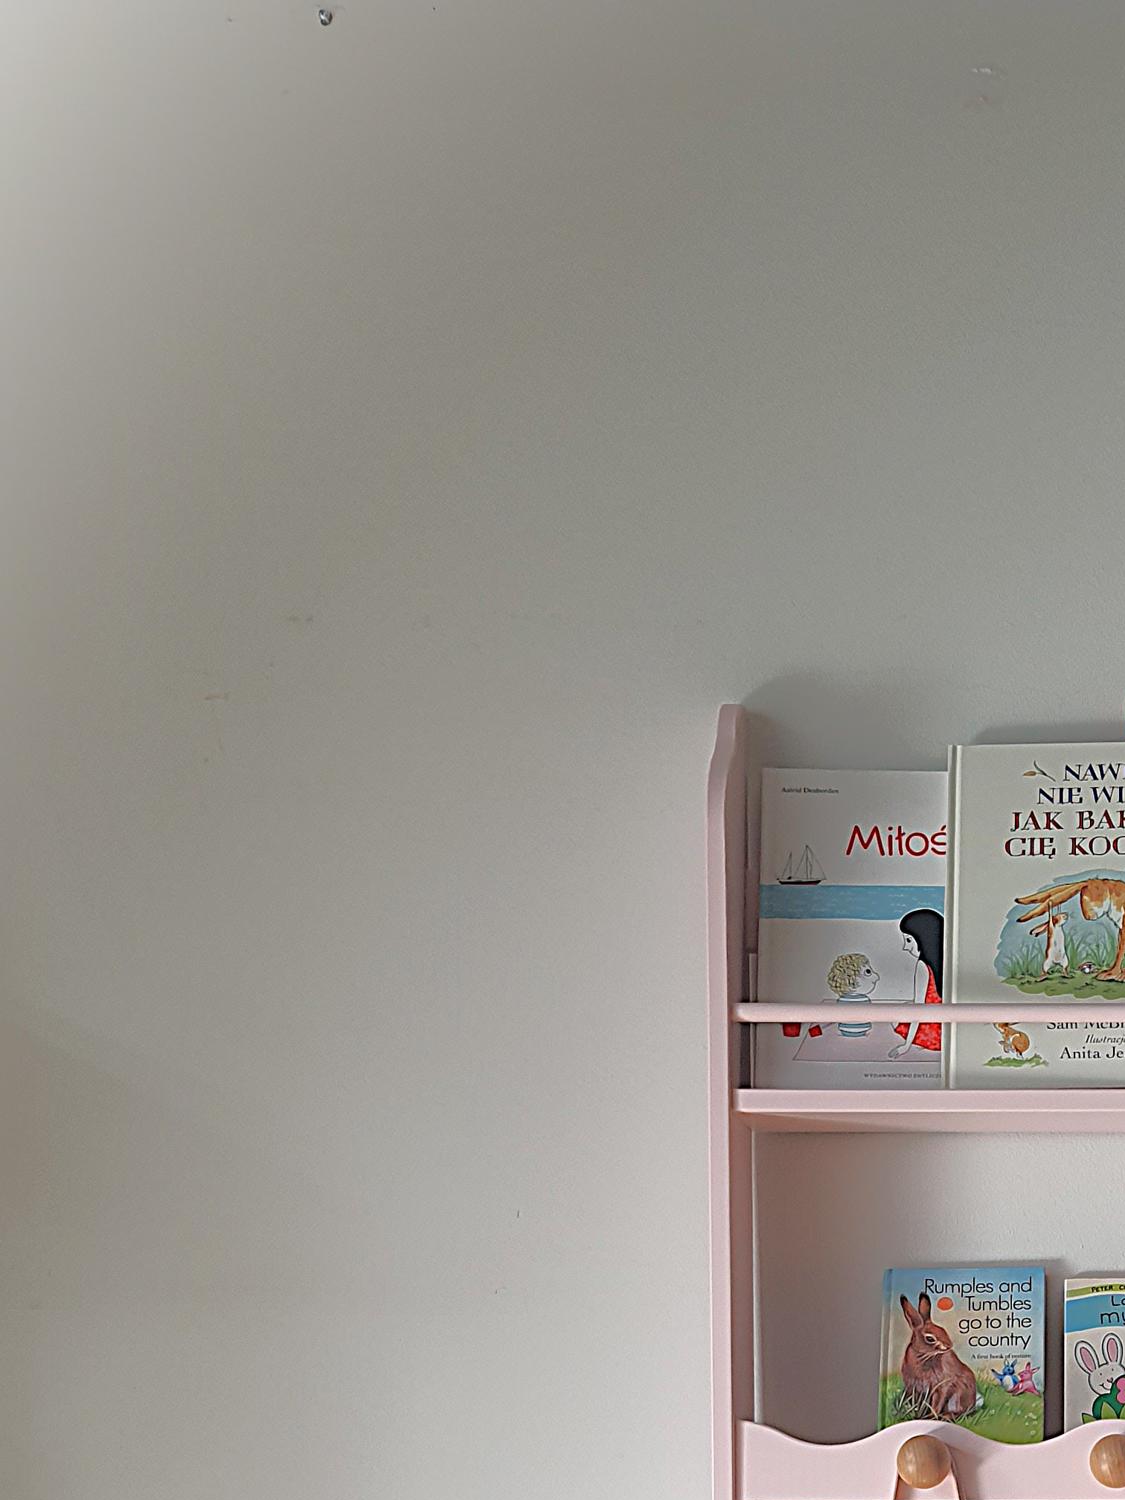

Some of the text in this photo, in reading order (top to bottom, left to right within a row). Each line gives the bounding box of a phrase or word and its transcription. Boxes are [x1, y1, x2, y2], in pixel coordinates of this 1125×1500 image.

[1036, 786, 1083, 804] NIE
[1010, 810, 1064, 832] JAK
[1004, 837, 1056, 859] CIĘ
[1060, 1046, 1100, 1059] Anita
[925, 1275, 1032, 1297] Rumples and
[1091, 1284, 1114, 1293] PETER
[965, 1294, 1032, 1312] Tumbles
[958, 1312, 1032, 1334] go to the
[968, 1332, 1031, 1350] country
